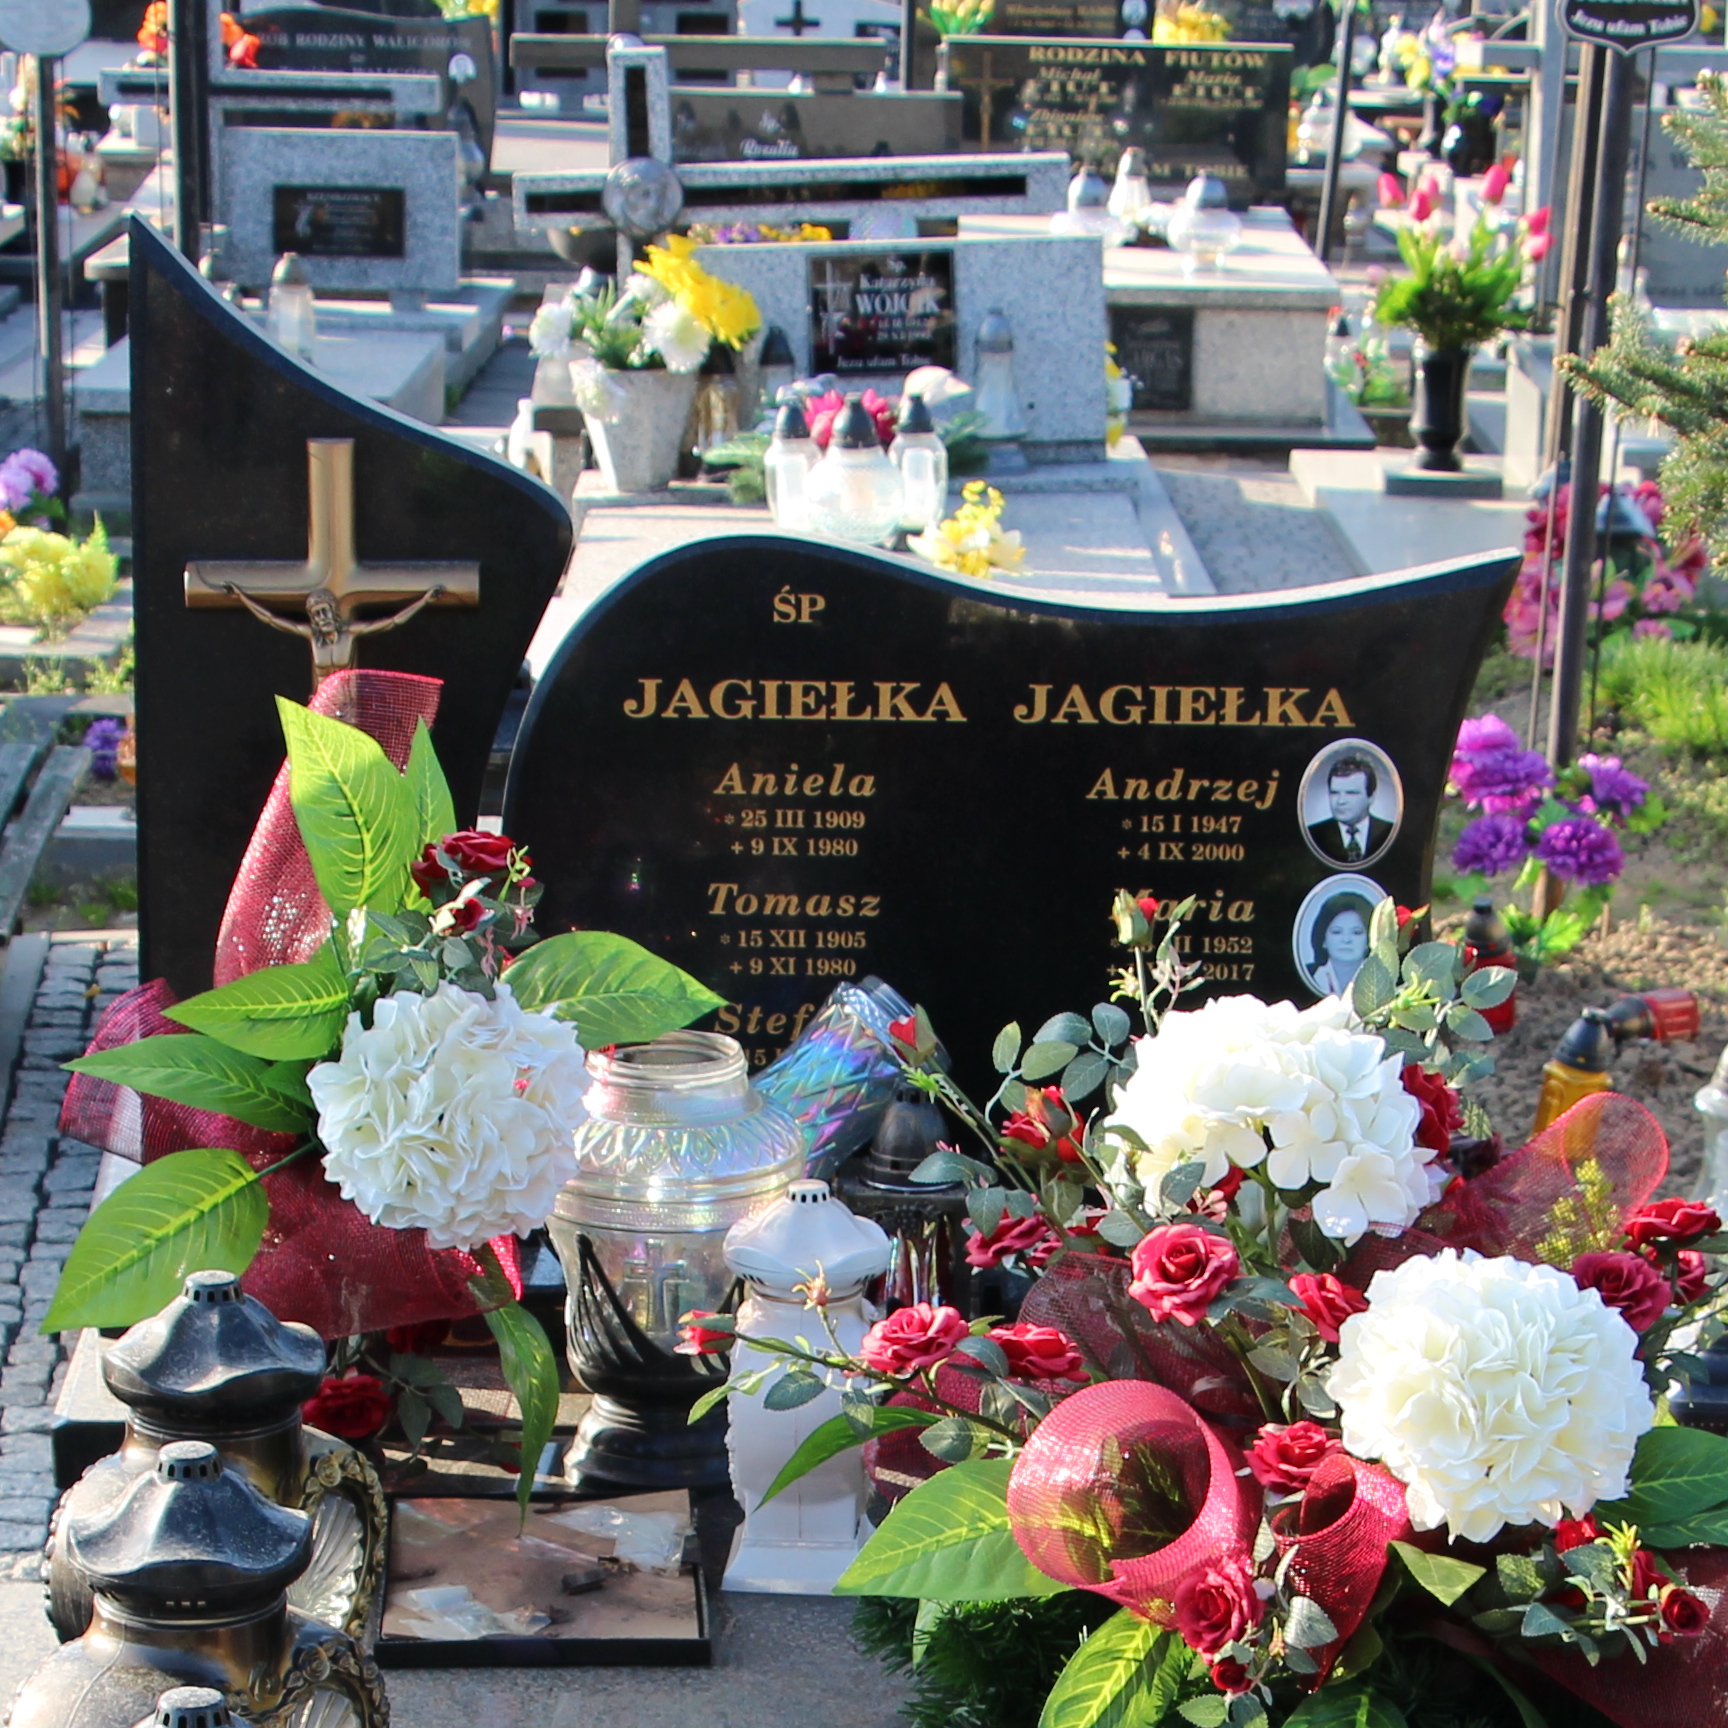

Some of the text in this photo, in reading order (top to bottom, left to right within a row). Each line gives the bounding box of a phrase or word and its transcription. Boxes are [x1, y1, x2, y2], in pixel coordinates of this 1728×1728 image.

[1570, 8, 1689, 37] Jezu ufam Tobie
[1028, 45, 1147, 66] RODZINA
[772, 585, 826, 623] ŚP
[622, 678, 968, 722] JAGIEŁKA
[1013, 683, 1356, 727] JAGIEŁKA
[713, 762, 876, 797] Aniela
[1085, 767, 1281, 810] Andrzej
[740, 809, 866, 829] 25 III 1909
[1139, 815, 1243, 834] 15 I 1947
[750, 837, 765, 857] 9
[771, 837, 799, 857] IX
[806, 837, 859, 857] 1980
[1137, 843, 1151, 861] 4
[1158, 843, 1185, 861] IX
[1191, 843, 1245, 862] 2000
[706, 882, 881, 917] Tomasz
[1108, 887, 1256, 923] aria
[737, 929, 867, 949] 15 XII 1905
[1202, 935, 1254, 954] 1952
[749, 957, 763, 976] 9
[770, 957, 796, 976] XI
[804, 957, 857, 976] 1980
[1201, 962, 1256, 982] 2017
